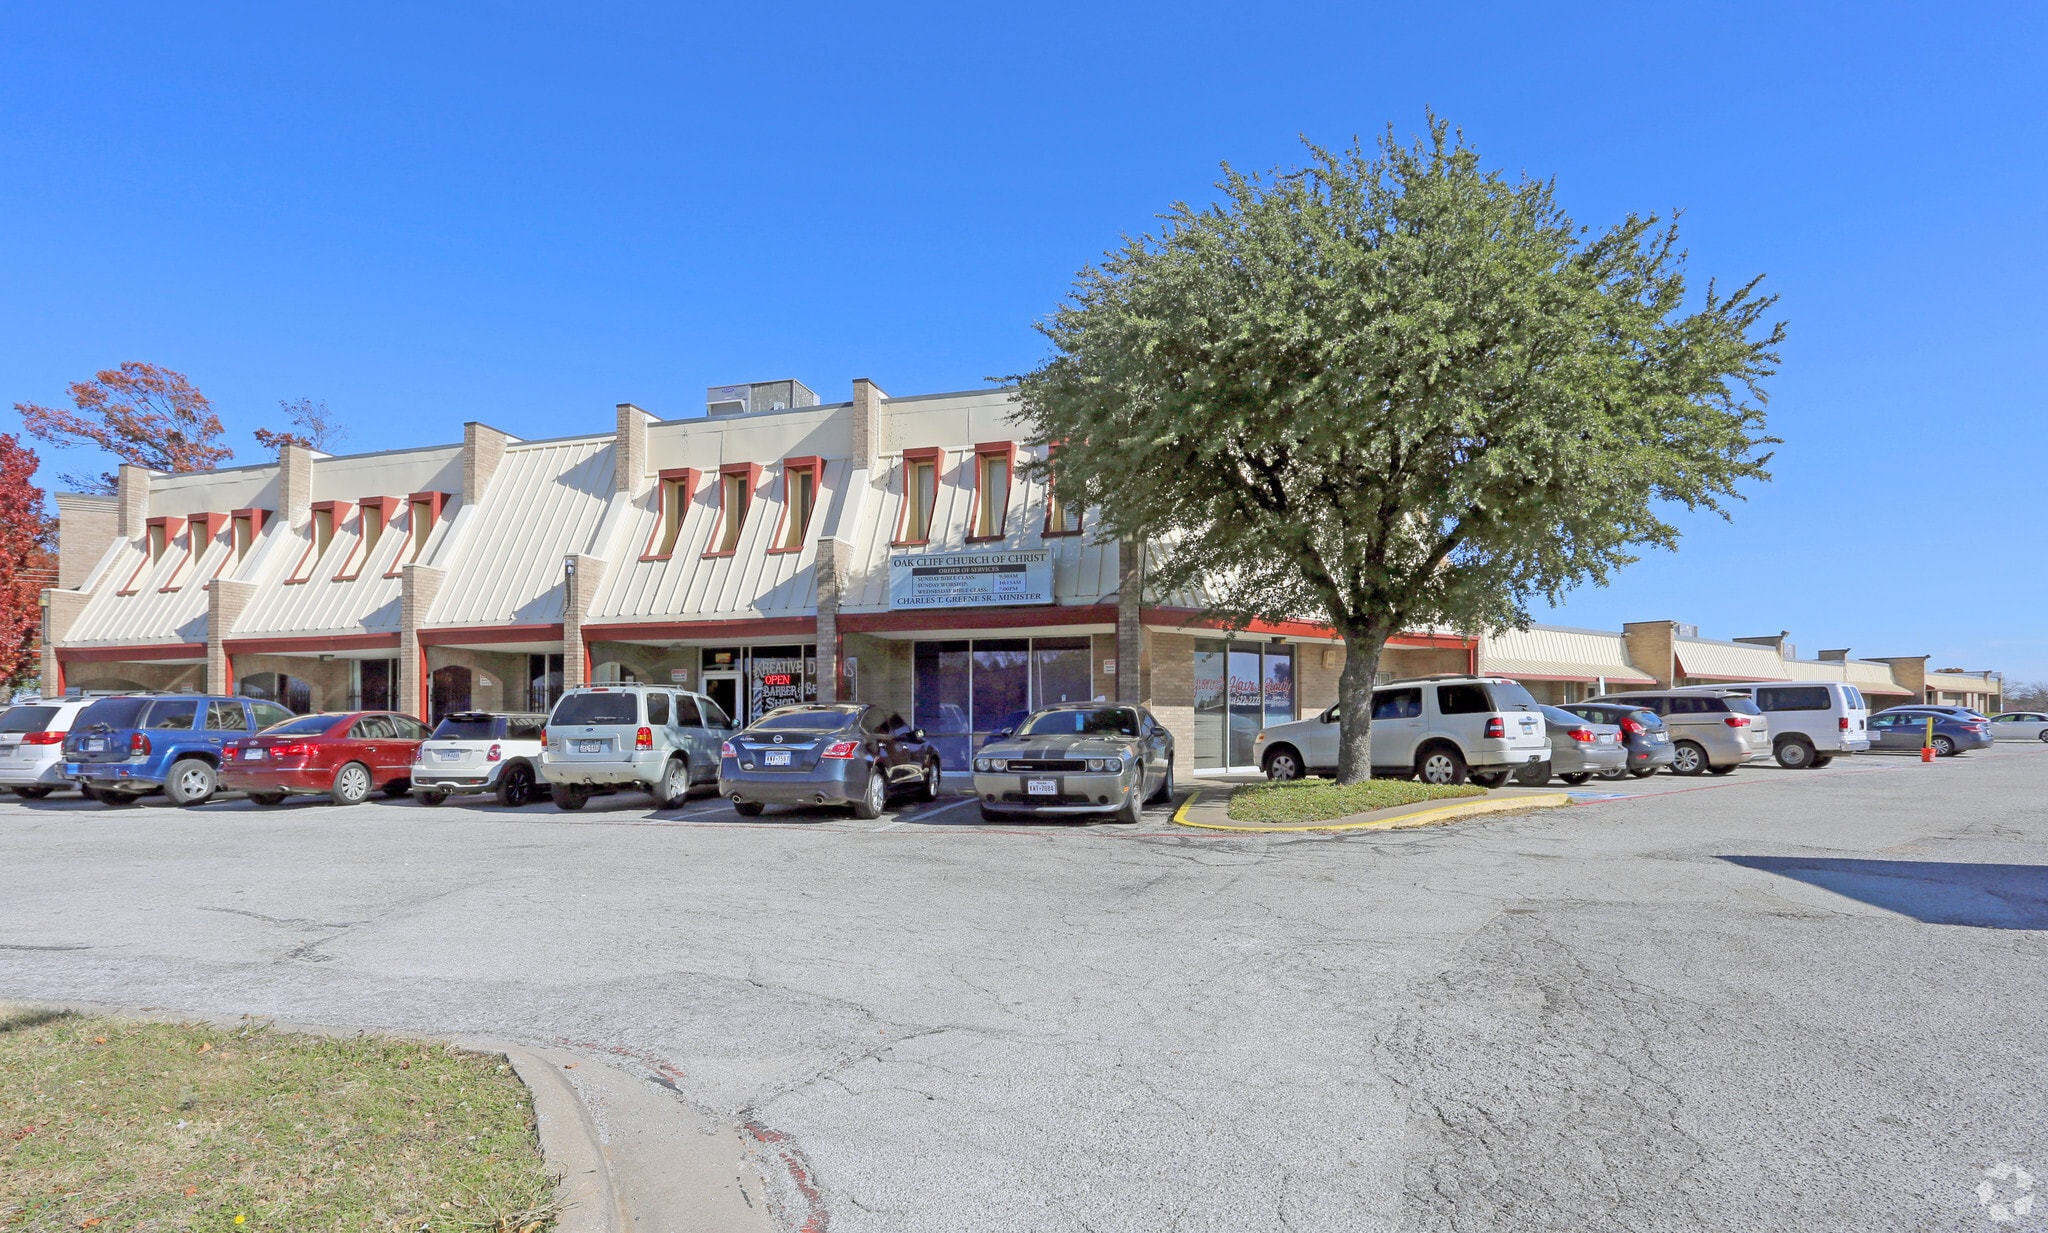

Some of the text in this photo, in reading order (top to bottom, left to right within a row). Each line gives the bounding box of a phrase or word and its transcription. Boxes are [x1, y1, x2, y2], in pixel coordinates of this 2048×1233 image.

[893, 553, 1047, 567] OAK CLIFF CHURCH OF CHRIST
[896, 597, 936, 605] CHARLES
[945, 595, 980, 603] GREENE
[998, 593, 1042, 601] MINISTER
[753, 660, 802, 677] KREATIVE
[764, 674, 791, 685] OPEN
[1229, 675, 1256, 696] Hair
